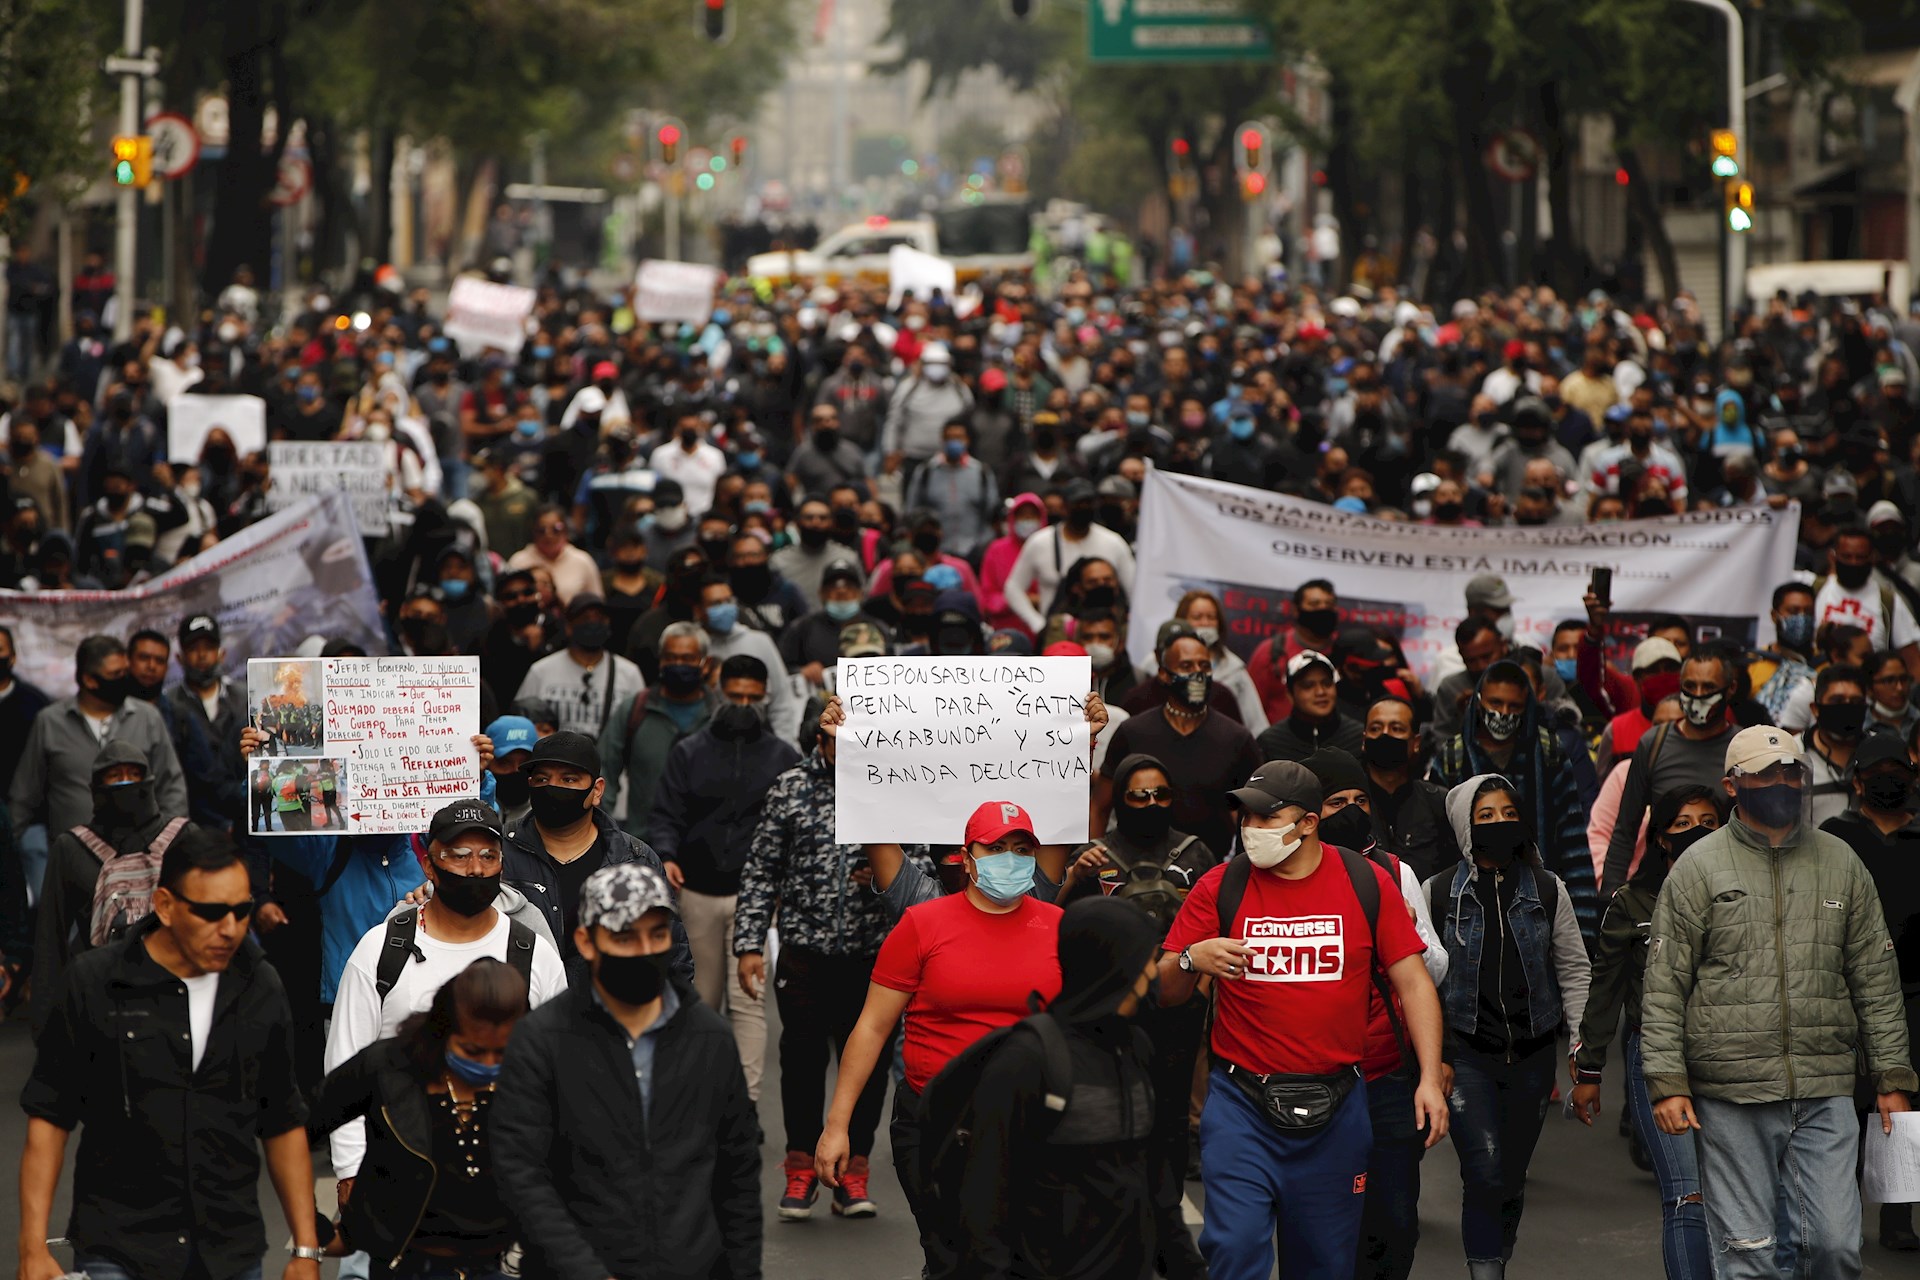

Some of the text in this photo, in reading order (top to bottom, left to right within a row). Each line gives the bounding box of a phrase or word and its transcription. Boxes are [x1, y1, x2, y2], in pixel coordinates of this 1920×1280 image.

[1271, 540, 1415, 568] OBSERVEN
[361, 663, 371, 672] DE
[422, 664, 433, 673] SU
[437, 662, 464, 673] NUEVO
[846, 663, 1046, 687] RESPONSABILIDAD
[326, 675, 370, 686] PROTOCOLO
[376, 678, 386, 687] DE
[343, 689, 354, 698] VA
[360, 689, 395, 699] INDICAR
[410, 688, 425, 700] QUE
[434, 688, 452, 699] TAN
[327, 699, 461, 716] QUEMADO DEBERÁ QUEDAR
[850, 693, 918, 716] PENAL
[935, 692, 994, 718] PARA
[350, 717, 386, 730] CUERPO
[395, 715, 415, 727] PARA
[422, 715, 447, 724] TENER
[327, 731, 362, 739] DERECHO
[380, 729, 407, 739] PODER
[1014, 729, 1028, 751] Y
[1045, 727, 1074, 747] SU
[384, 748, 394, 757] LE
[399, 745, 420, 756] PIDO
[426, 744, 441, 754] QUE
[444, 743, 453, 753] SE
[351, 763, 384, 772] DETENGA
[400, 756, 467, 771] REFLEXIONAR
[867, 756, 1089, 785] BANDA DELICTIVA
[382, 772, 406, 785] ANTES
[410, 774, 419, 783] DE
[423, 770, 438, 782] SER
[384, 788, 397, 798] UN
[402, 783, 420, 797] SER
[398, 821, 419, 832] QUEDA
[1251, 921, 1336, 937] CONVERSE
[1247, 945, 1341, 975] CONS
